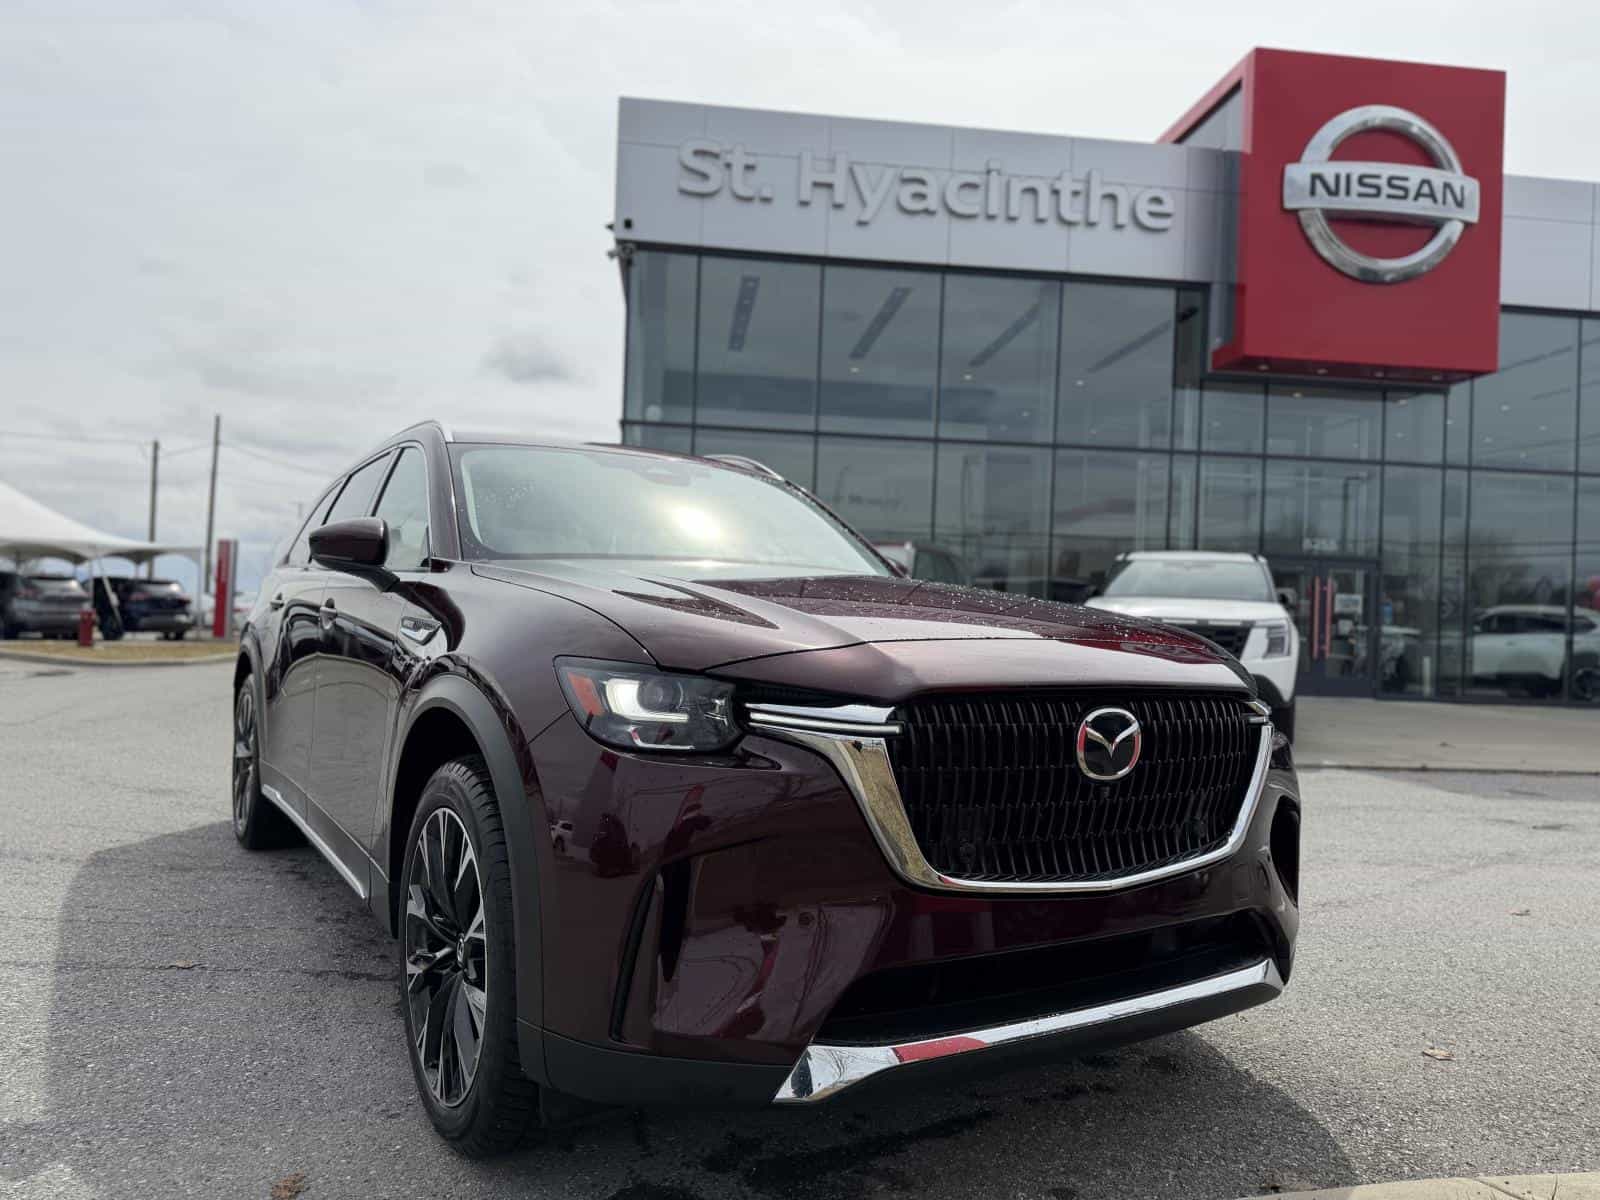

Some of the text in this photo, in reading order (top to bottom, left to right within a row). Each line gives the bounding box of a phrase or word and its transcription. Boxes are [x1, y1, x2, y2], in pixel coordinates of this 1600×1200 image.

[678, 138, 1175, 233] St. Hyacinthe
[1309, 172, 1465, 209] NISSAN
